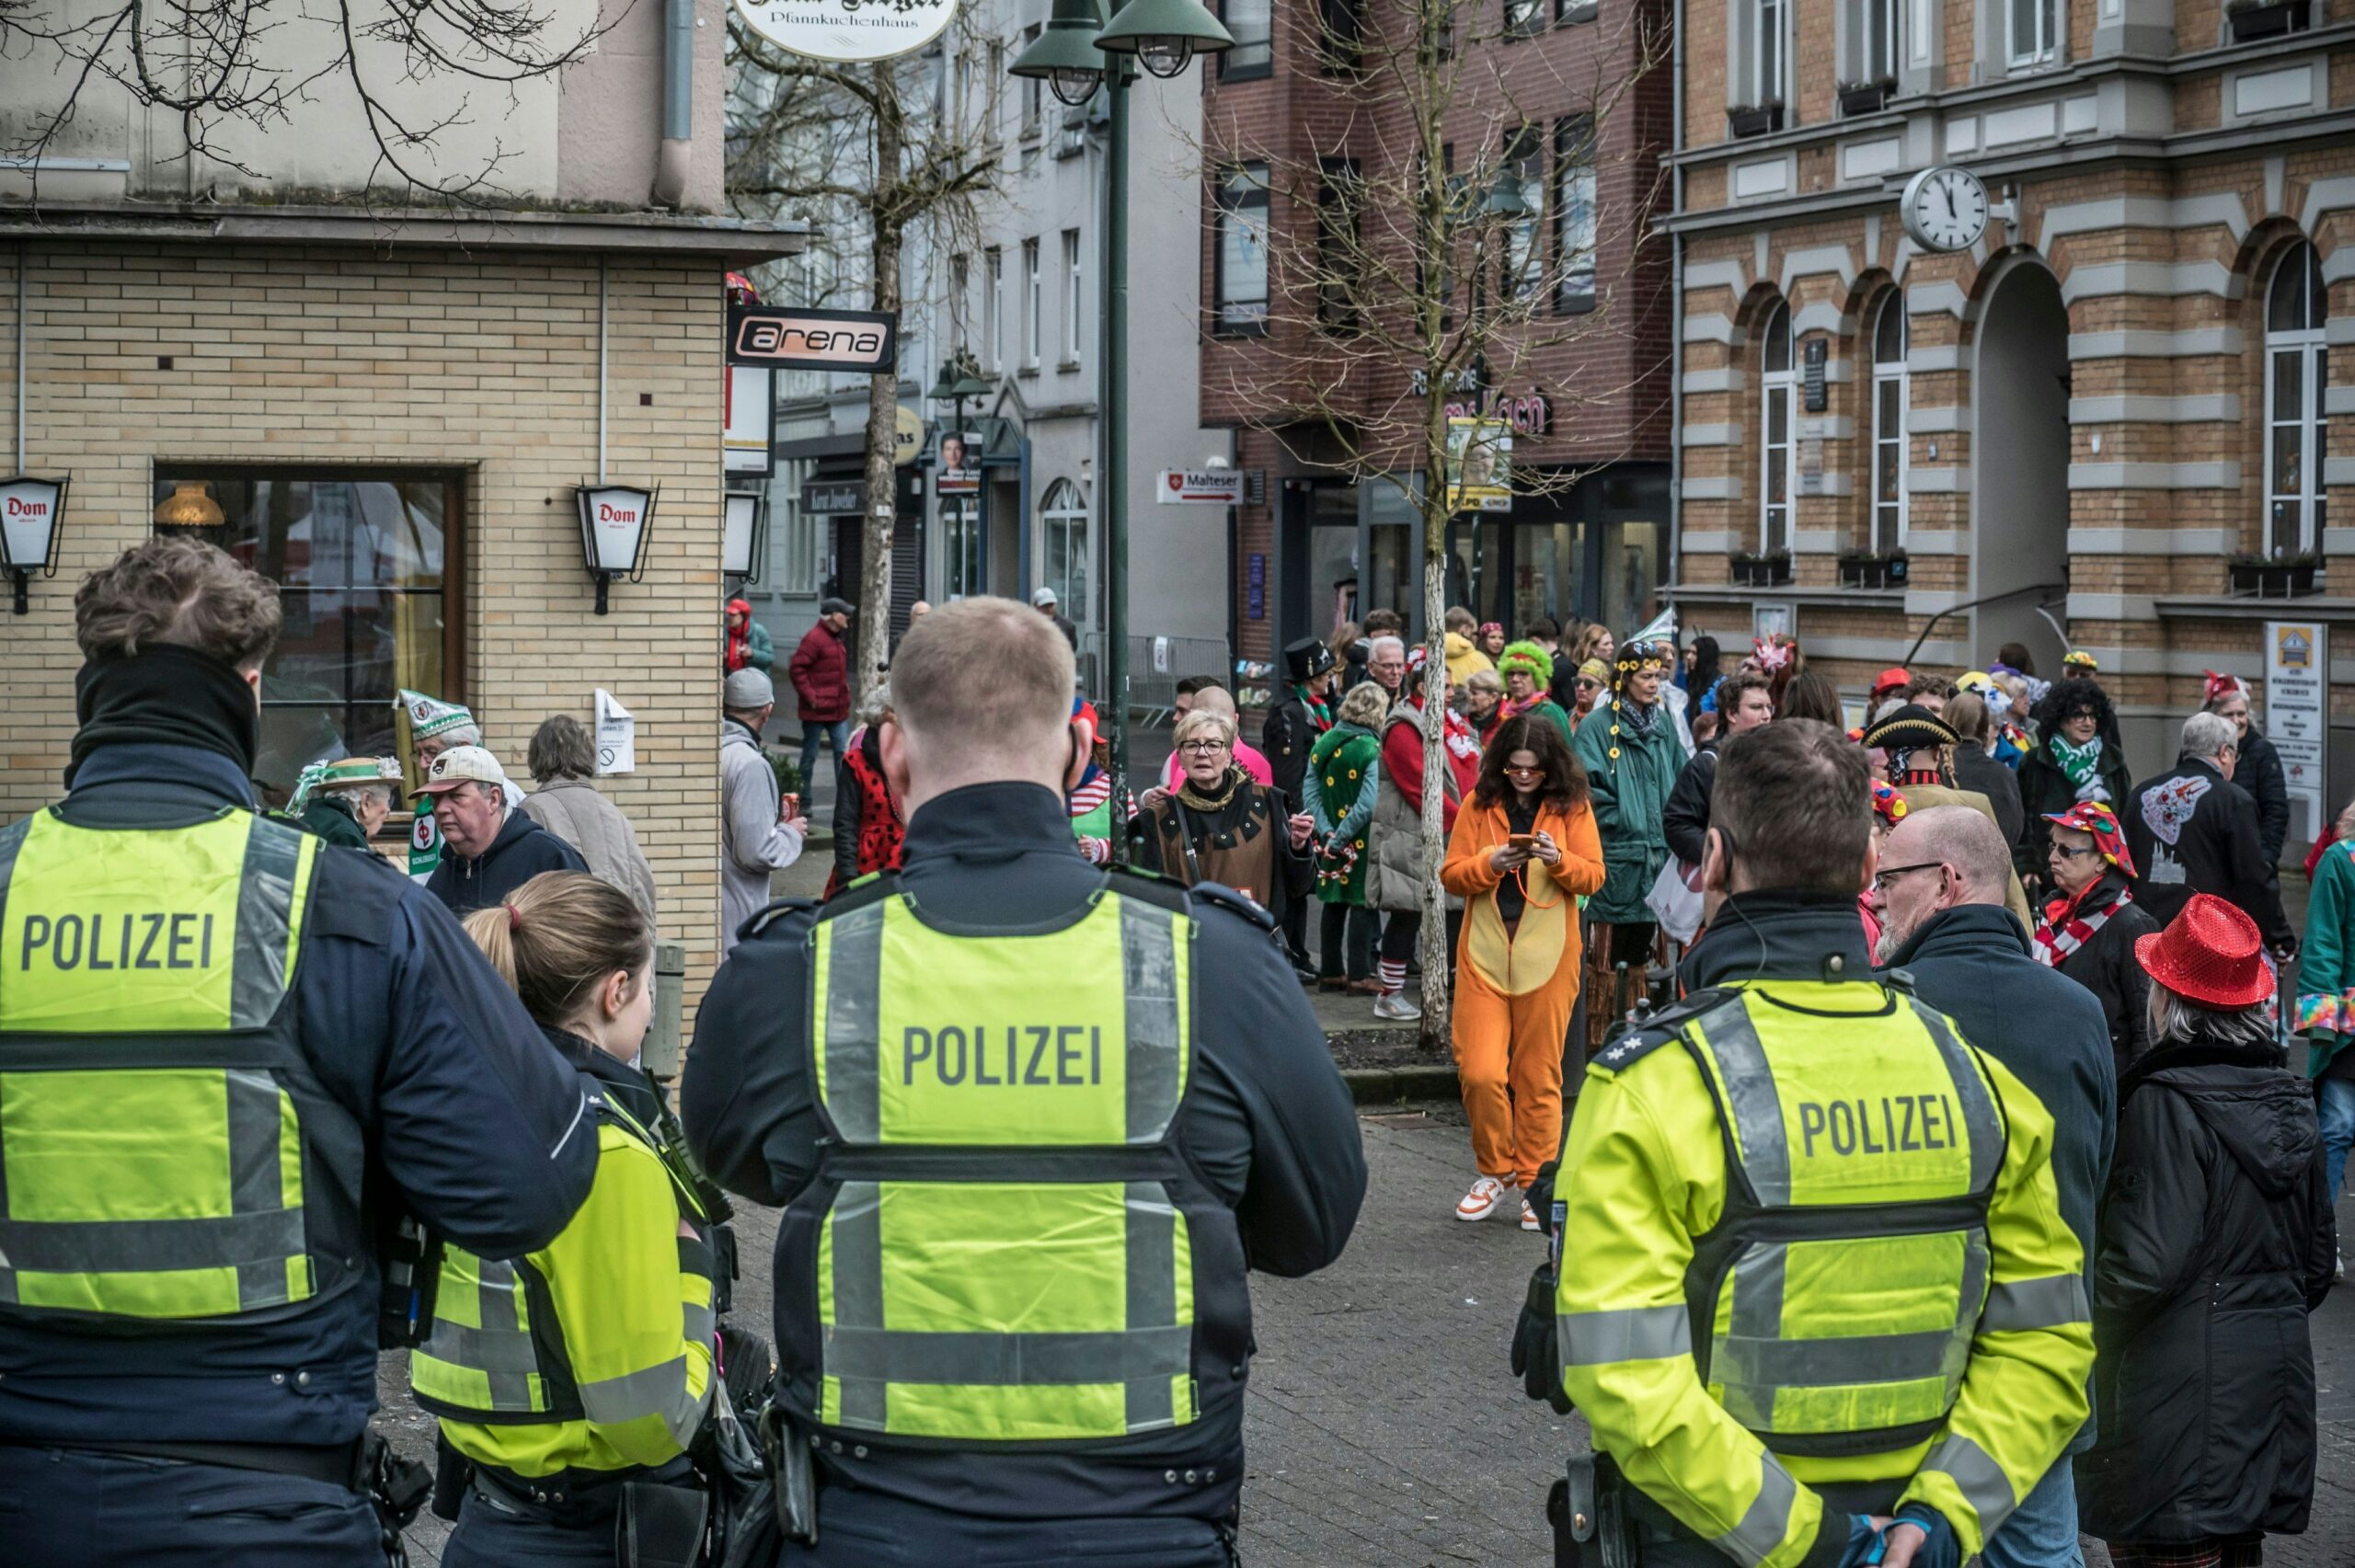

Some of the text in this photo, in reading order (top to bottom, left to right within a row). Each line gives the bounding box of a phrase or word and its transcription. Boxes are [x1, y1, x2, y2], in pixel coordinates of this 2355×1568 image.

[770, 11, 919, 29] Pfannkuchenhaus
[751, 326, 879, 353] arena
[1187, 474, 1238, 486] Malteser
[7, 497, 47, 516] Dom
[599, 503, 636, 523] Dom
[21, 912, 214, 971] POLIZEI
[903, 1025, 1101, 1086] POLIZEI
[1798, 1093, 1957, 1158] POLIZEI
